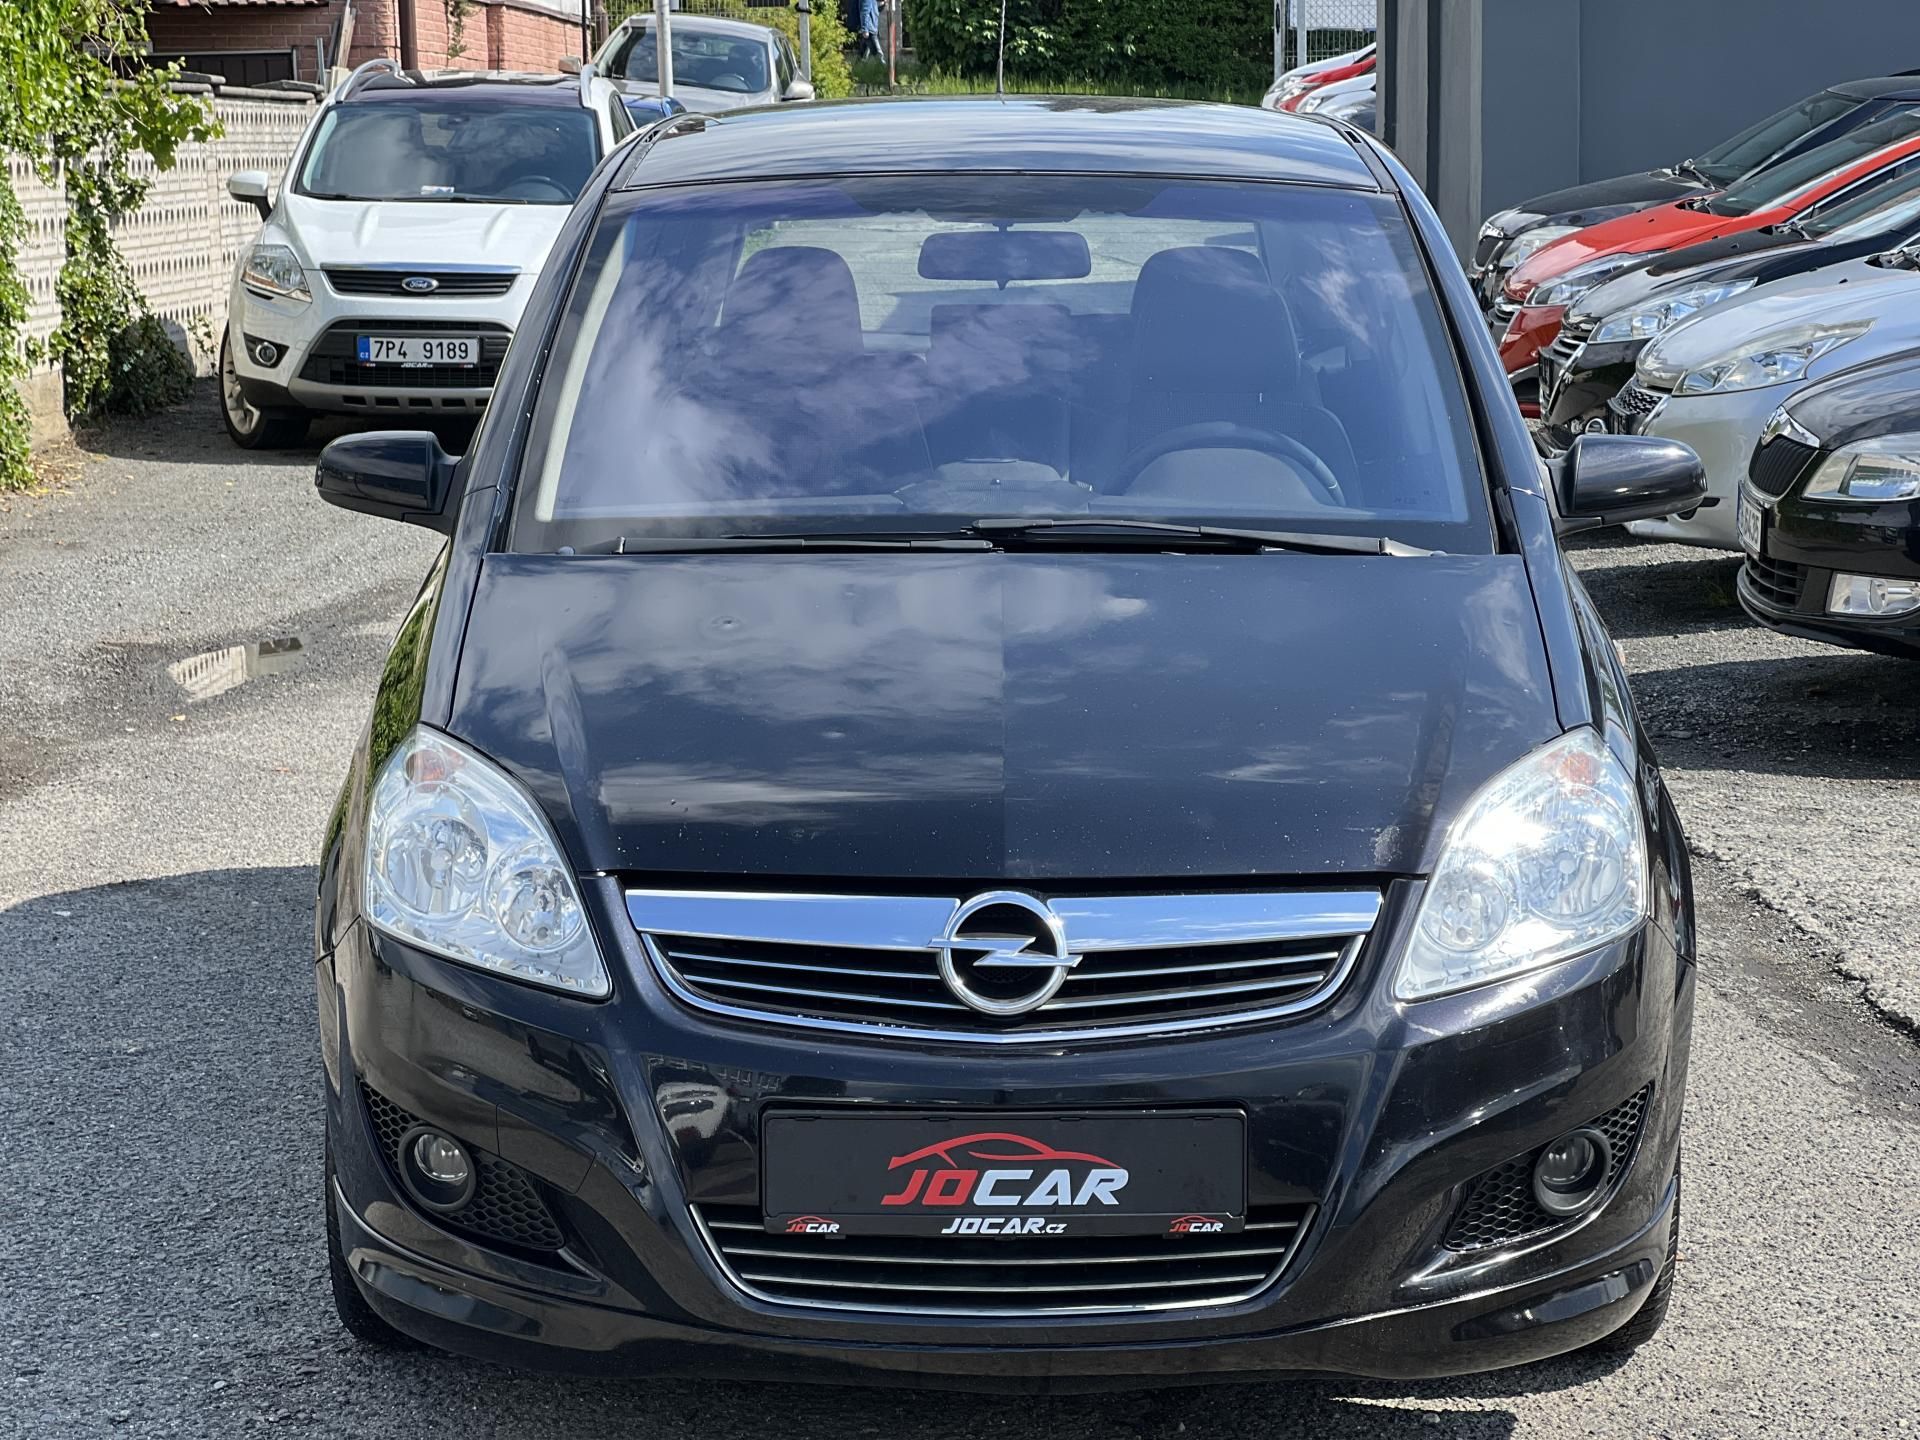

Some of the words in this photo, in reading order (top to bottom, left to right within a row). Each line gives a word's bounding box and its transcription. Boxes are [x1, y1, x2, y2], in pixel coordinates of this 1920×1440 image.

[374, 340, 408, 359] 7P4
[423, 341, 469, 360] 9189
[880, 1169, 1130, 1206] JOCAR
[785, 1223, 840, 1233] JOCAR
[941, 1217, 1068, 1235] JOCAR.cz
[1169, 1222, 1224, 1233] JOCAR
